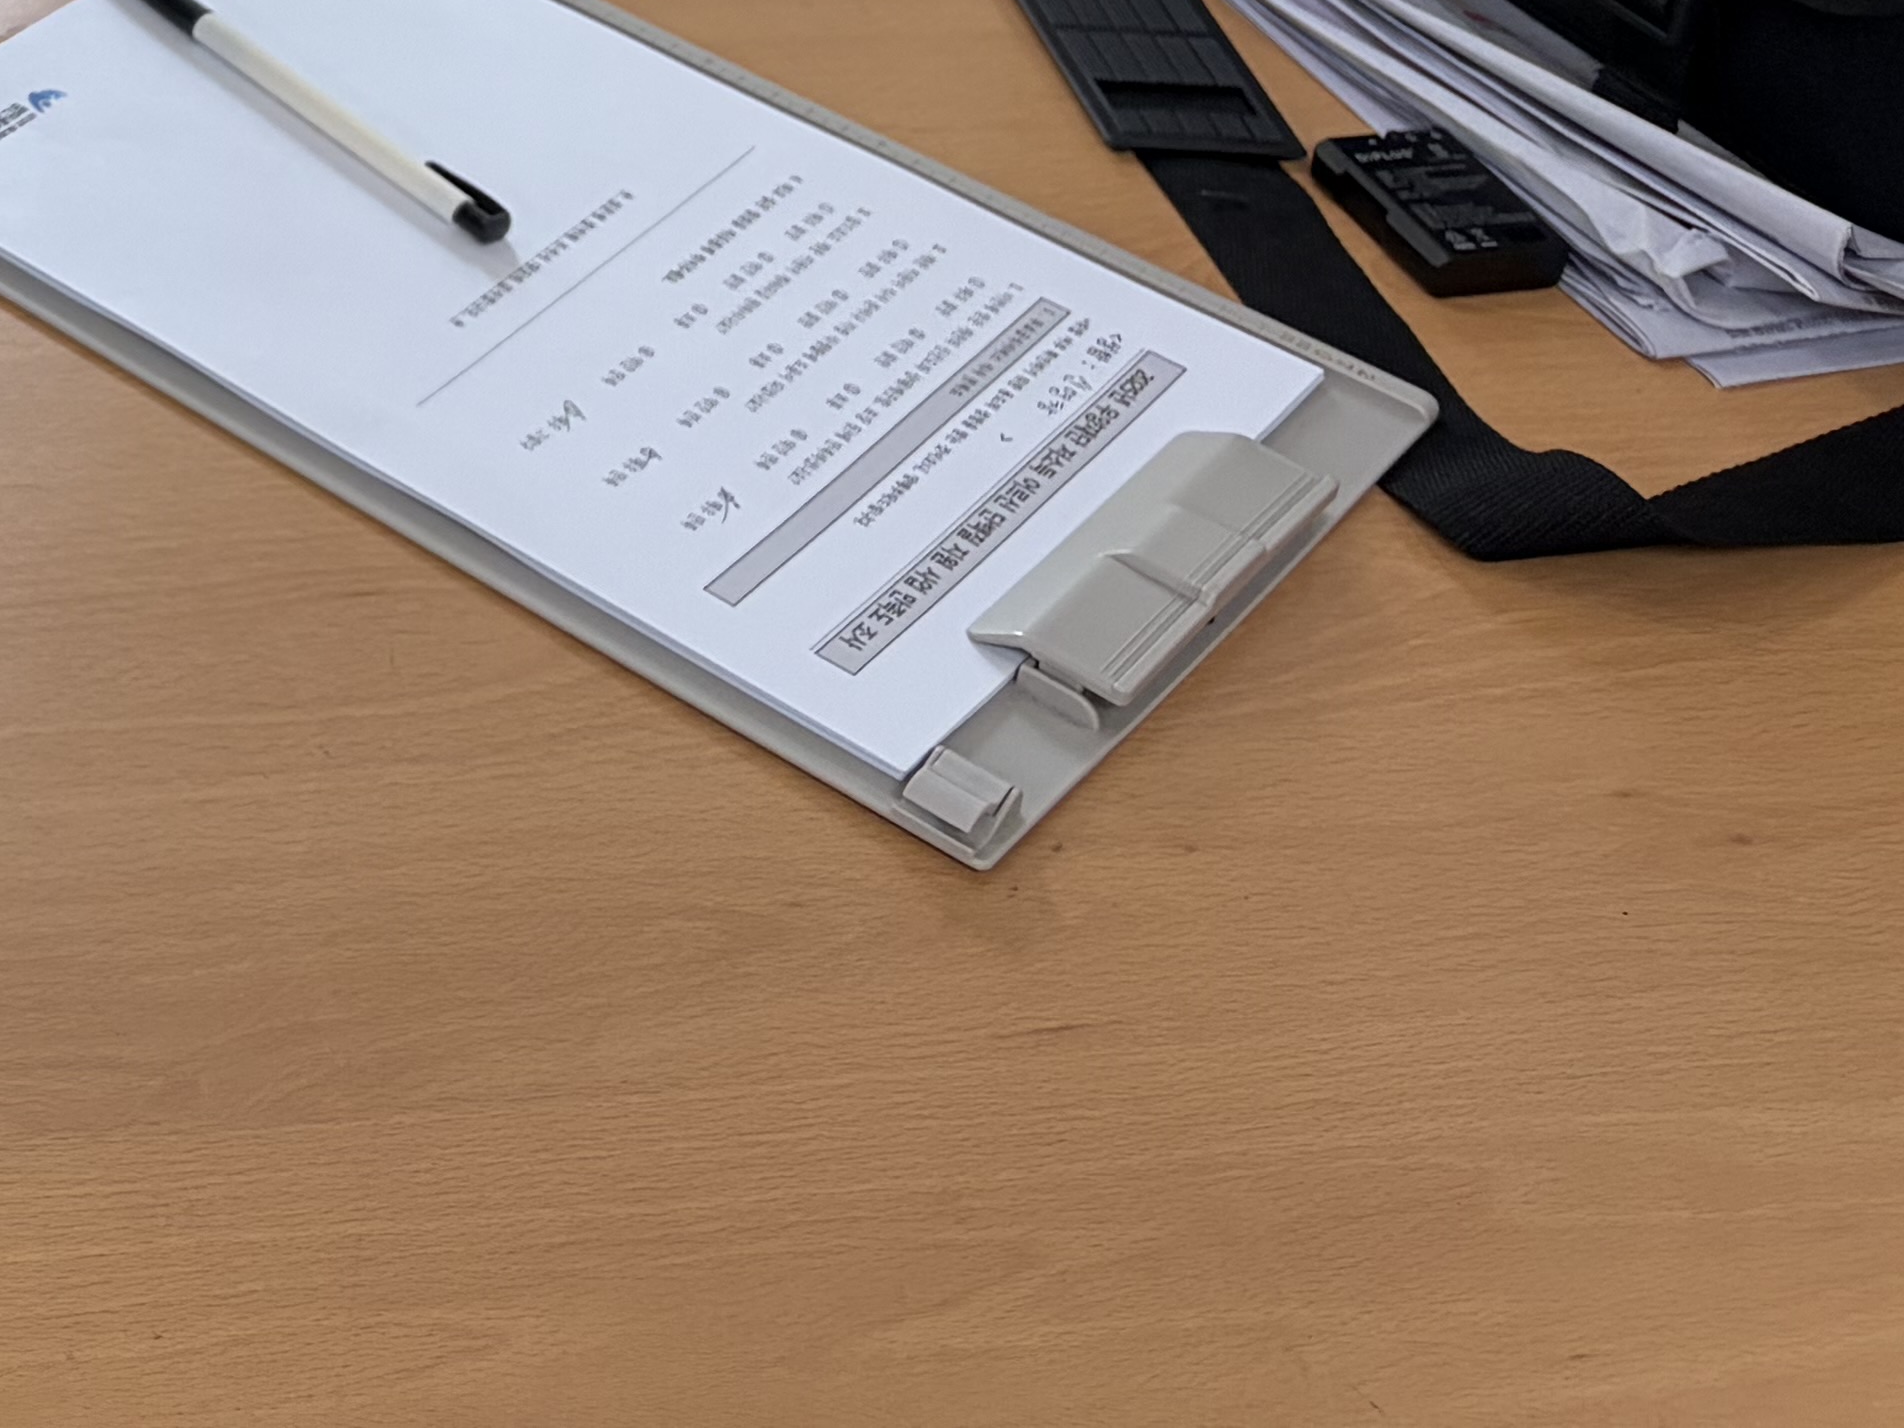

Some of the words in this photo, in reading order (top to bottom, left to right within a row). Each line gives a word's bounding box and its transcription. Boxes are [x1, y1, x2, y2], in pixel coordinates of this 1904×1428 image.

[1109, 370, 1157, 405] 2025년
[1065, 404, 1120, 445] 우양재단
[1030, 443, 1077, 477] 저소득
[995, 476, 1042, 510] 어르신
[958, 509, 1006, 544] 단백질
[931, 542, 969, 568] 지원
[905, 566, 943, 592] 사업
[868, 590, 916, 625] 만족도
[839, 622, 878, 649] 조사
